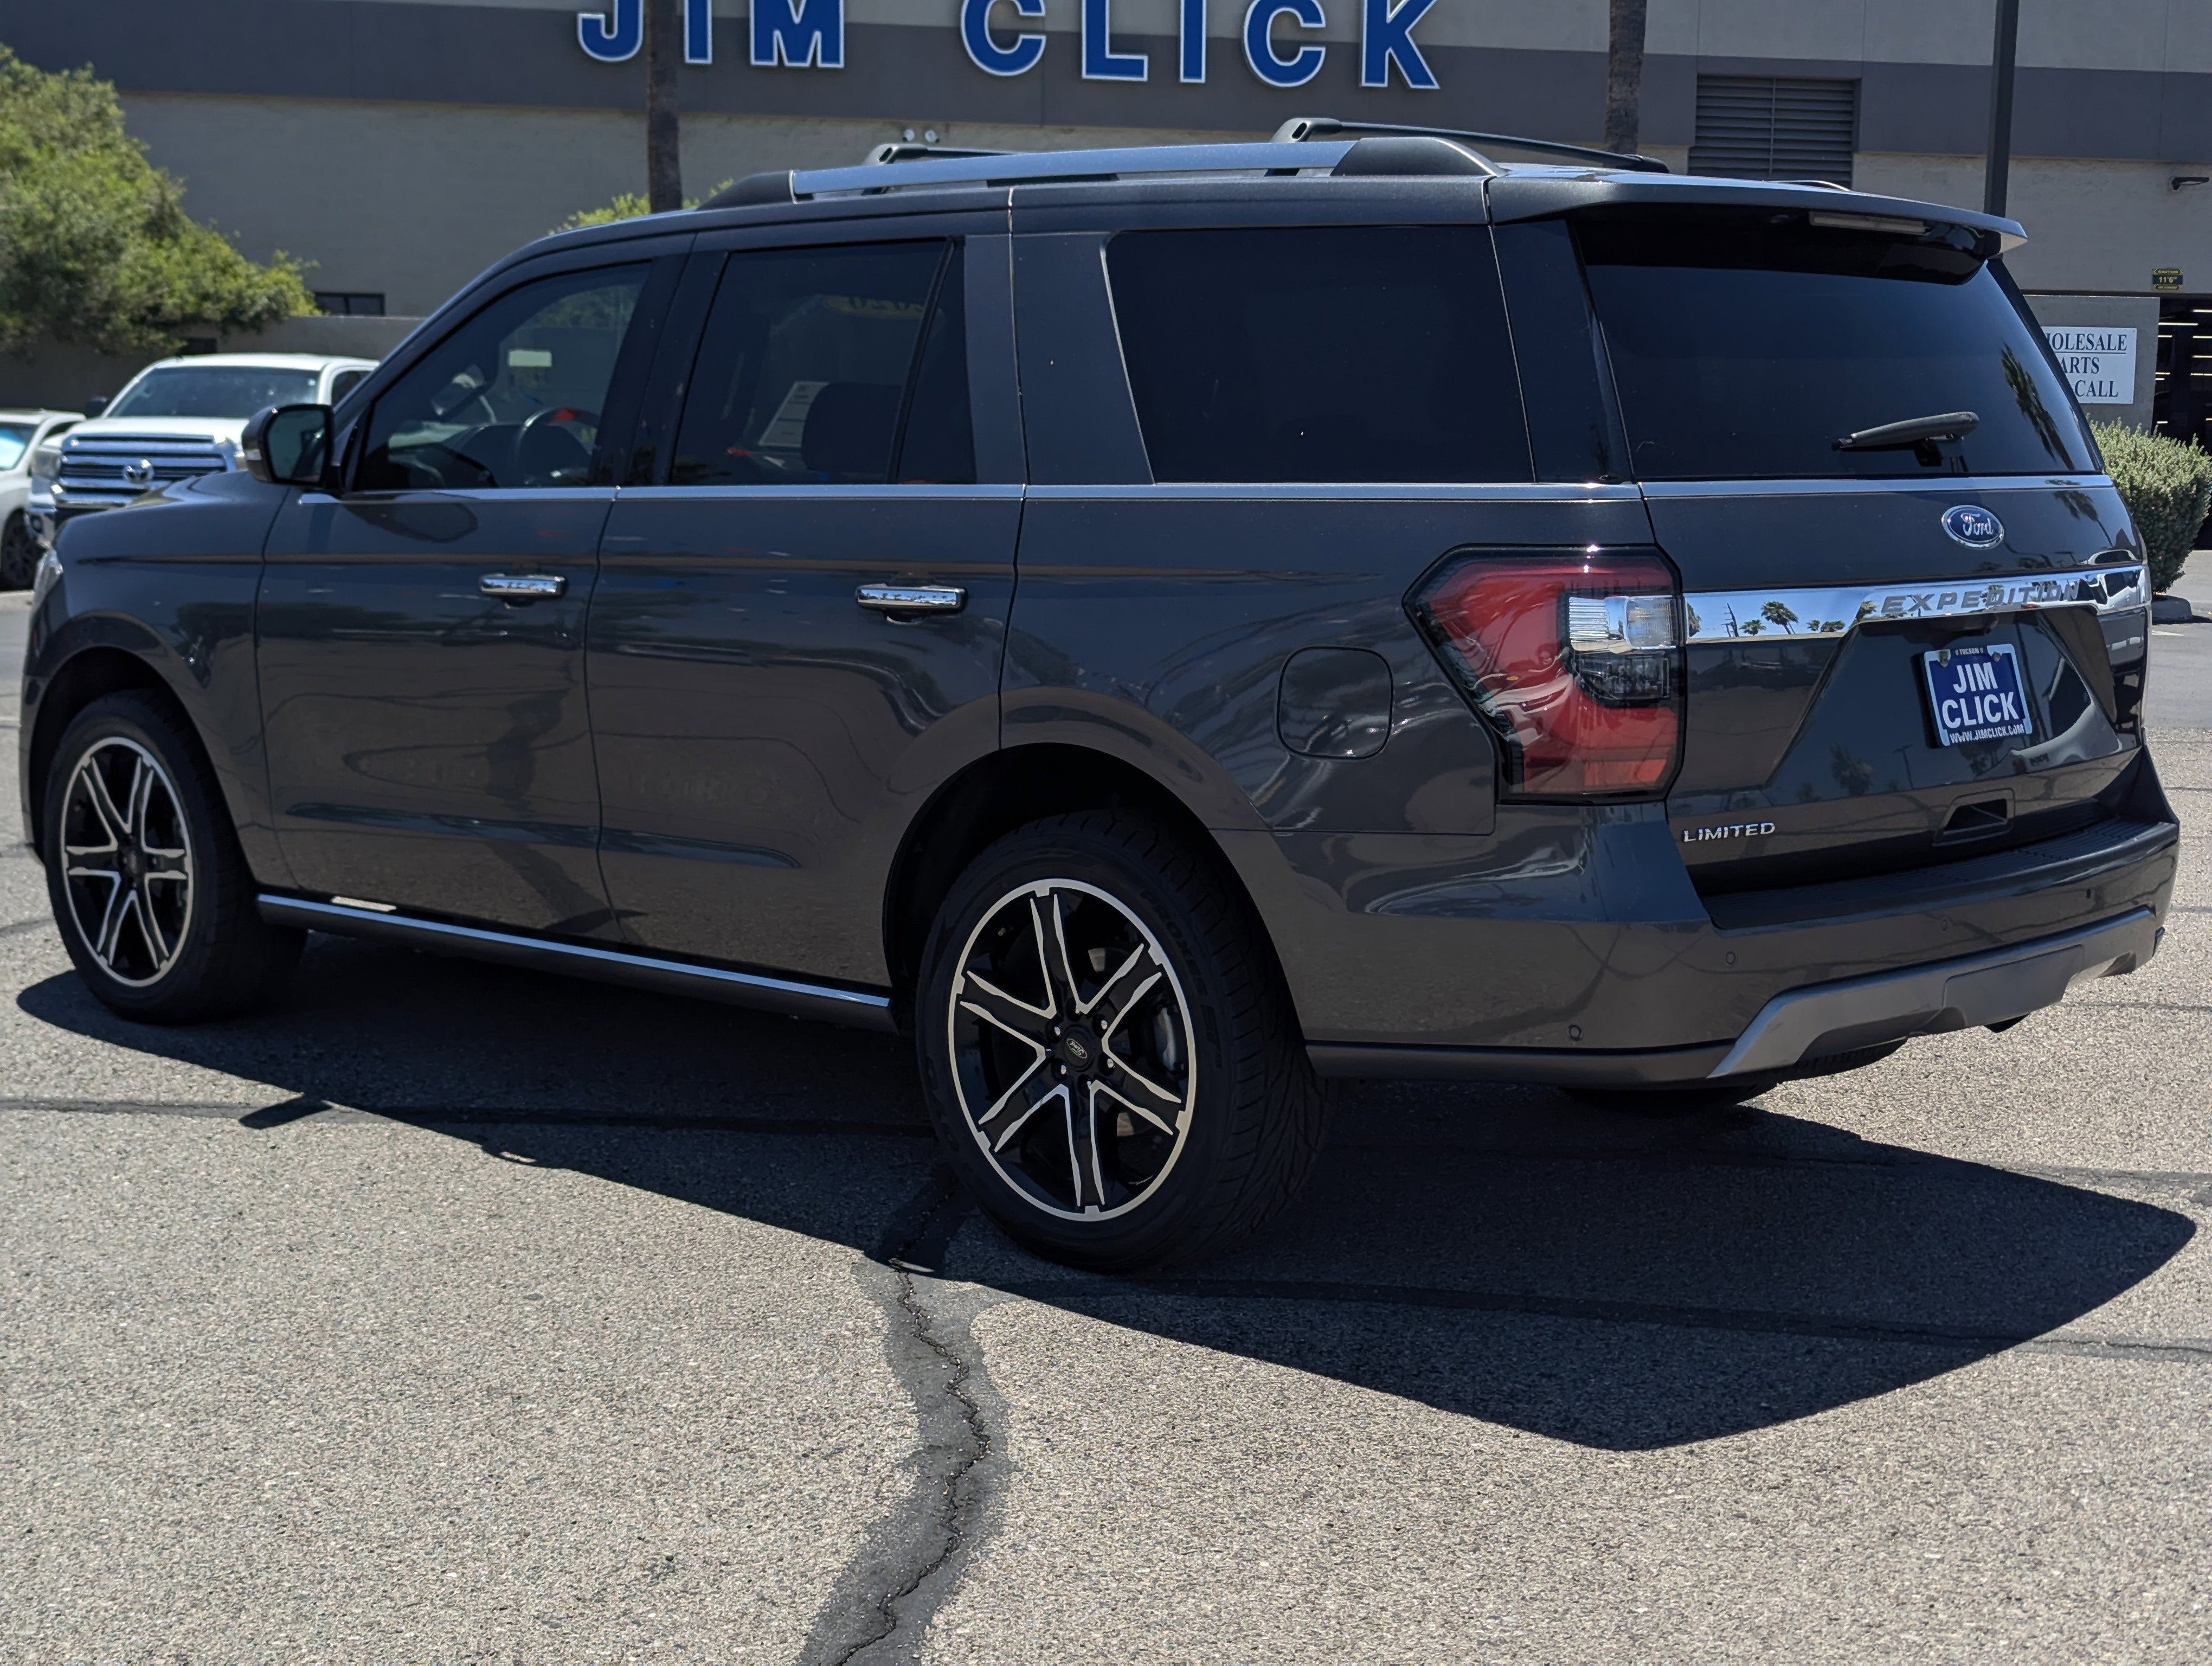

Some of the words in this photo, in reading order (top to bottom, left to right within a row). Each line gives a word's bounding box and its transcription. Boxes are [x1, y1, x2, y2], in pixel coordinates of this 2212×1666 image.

[577, 0, 845, 68] JIM
[960, 0, 1440, 89] CLICK
[2046, 332, 2127, 351] OLESALE
[2060, 356, 2100, 374] ARTS
[2074, 380, 2118, 398] CALL
[1960, 512, 1994, 536] Ford
[1881, 579, 2080, 613] EXPEDITION
[1959, 647, 1979, 656] TUCSON
[1953, 662, 1998, 694] JIM
[1941, 691, 2020, 729] CLICK
[1950, 723, 2025, 744] WWW.JIMCLICK.COM
[1684, 822, 1776, 842] LIMITED
[1069, 1041, 1084, 1056] Ford
